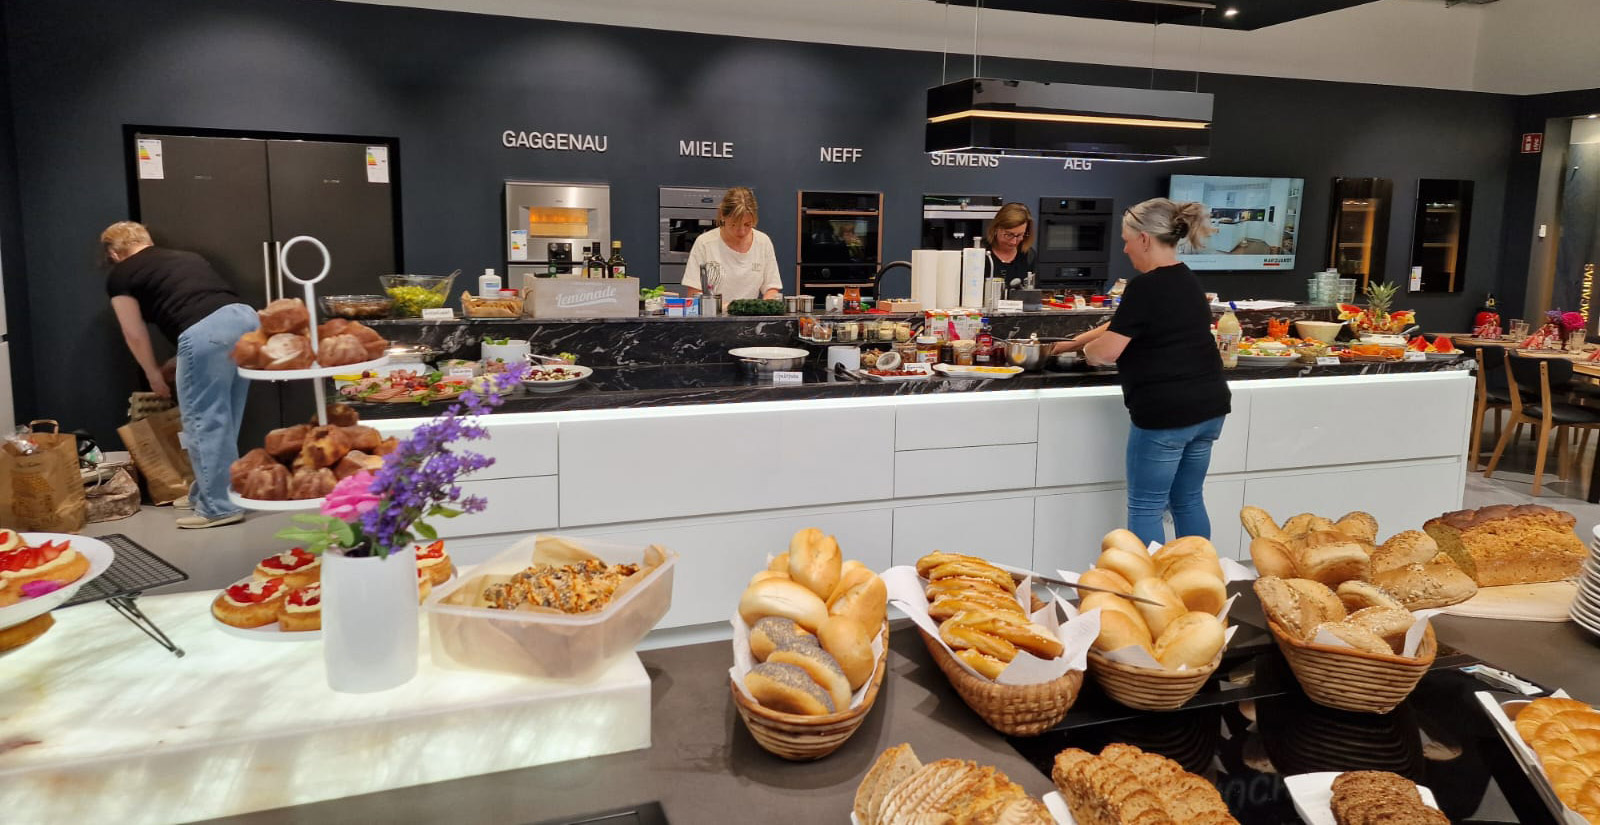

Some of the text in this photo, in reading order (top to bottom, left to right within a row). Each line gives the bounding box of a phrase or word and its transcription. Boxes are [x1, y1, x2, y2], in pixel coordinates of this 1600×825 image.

[502, 129, 608, 152] GAGGENAU
[679, 140, 734, 158] MIELE
[820, 146, 863, 163] NEFF
[930, 153, 999, 168] SIEMENS
[1063, 157, 1092, 171] AEG
[555, 285, 617, 308] Lemonade
